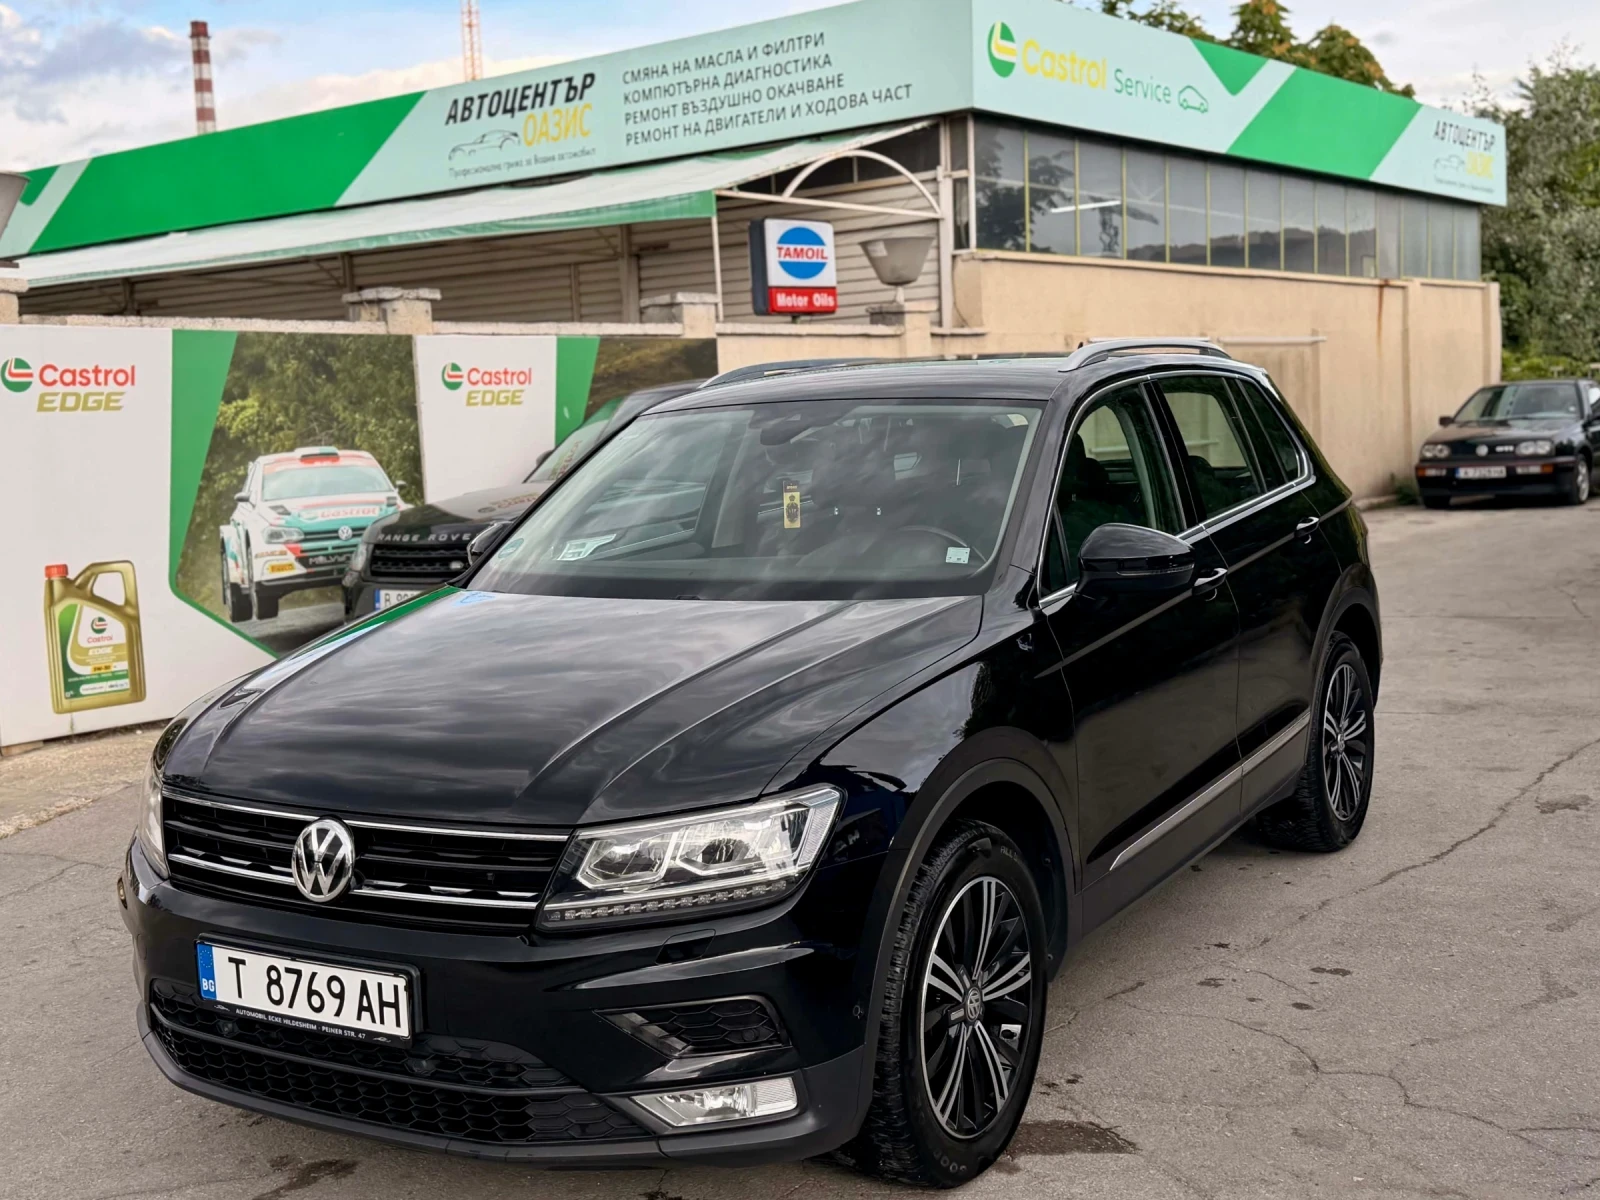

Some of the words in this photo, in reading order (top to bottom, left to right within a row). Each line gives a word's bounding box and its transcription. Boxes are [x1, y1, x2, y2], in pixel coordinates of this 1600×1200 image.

[622, 63, 669, 84] СМЯНА
[672, 59, 691, 75] НА
[694, 49, 744, 70] МАСЛА
[747, 45, 758, 60] И
[762, 32, 825, 56] ФИЛТРИ
[1021, 38, 1108, 90] Castrol
[1114, 68, 1171, 104] Service
[623, 75, 720, 105] КОМПЮТЪРНА
[723, 53, 832, 90] ДИАГНОСТИКА
[444, 72, 596, 126] АВТОЦЕНТЪР
[625, 104, 678, 125] РЕМОНТ
[682, 89, 762, 116] ВЪЗДУШНО
[766, 73, 844, 101] ОКАЧВАНЕ
[626, 125, 679, 146] РЕМОНТ
[683, 121, 702, 137] НА
[705, 106, 786, 137] ДВИГАТЕЛИ
[791, 104, 801, 118] И
[805, 92, 868, 116] ХОДОВА
[872, 84, 912, 103] ЧАСТ
[522, 102, 593, 147] ОАЗИС
[1433, 120, 1495, 152] АВТОЦЕНТЪР
[776, 247, 828, 260] TAMOIL
[776, 293, 808, 307] Motor
[812, 293, 834, 307] Oils
[39, 364, 135, 387] Castrol
[467, 367, 532, 386] Castrol
[36, 391, 126, 412] EDGE
[466, 389, 525, 407] EDGE
[377, 533, 420, 541] RANGE
[428, 533, 473, 541] ROVE
[87, 635, 113, 644] Castrol
[202, 978, 215, 992] BG
[228, 956, 246, 999] T
[266, 964, 345, 1017] 8769
[356, 979, 401, 1029] AH
[235, 1008, 267, 1021] AUTOMOBIL
[268, 1015, 283, 1024] ECKE
[283, 1017, 317, 1031] HILDESHEIM
[321, 1025, 343, 1036] PEINER
[344, 1029, 357, 1038] STR.
[357, 1031, 366, 1040] 47
